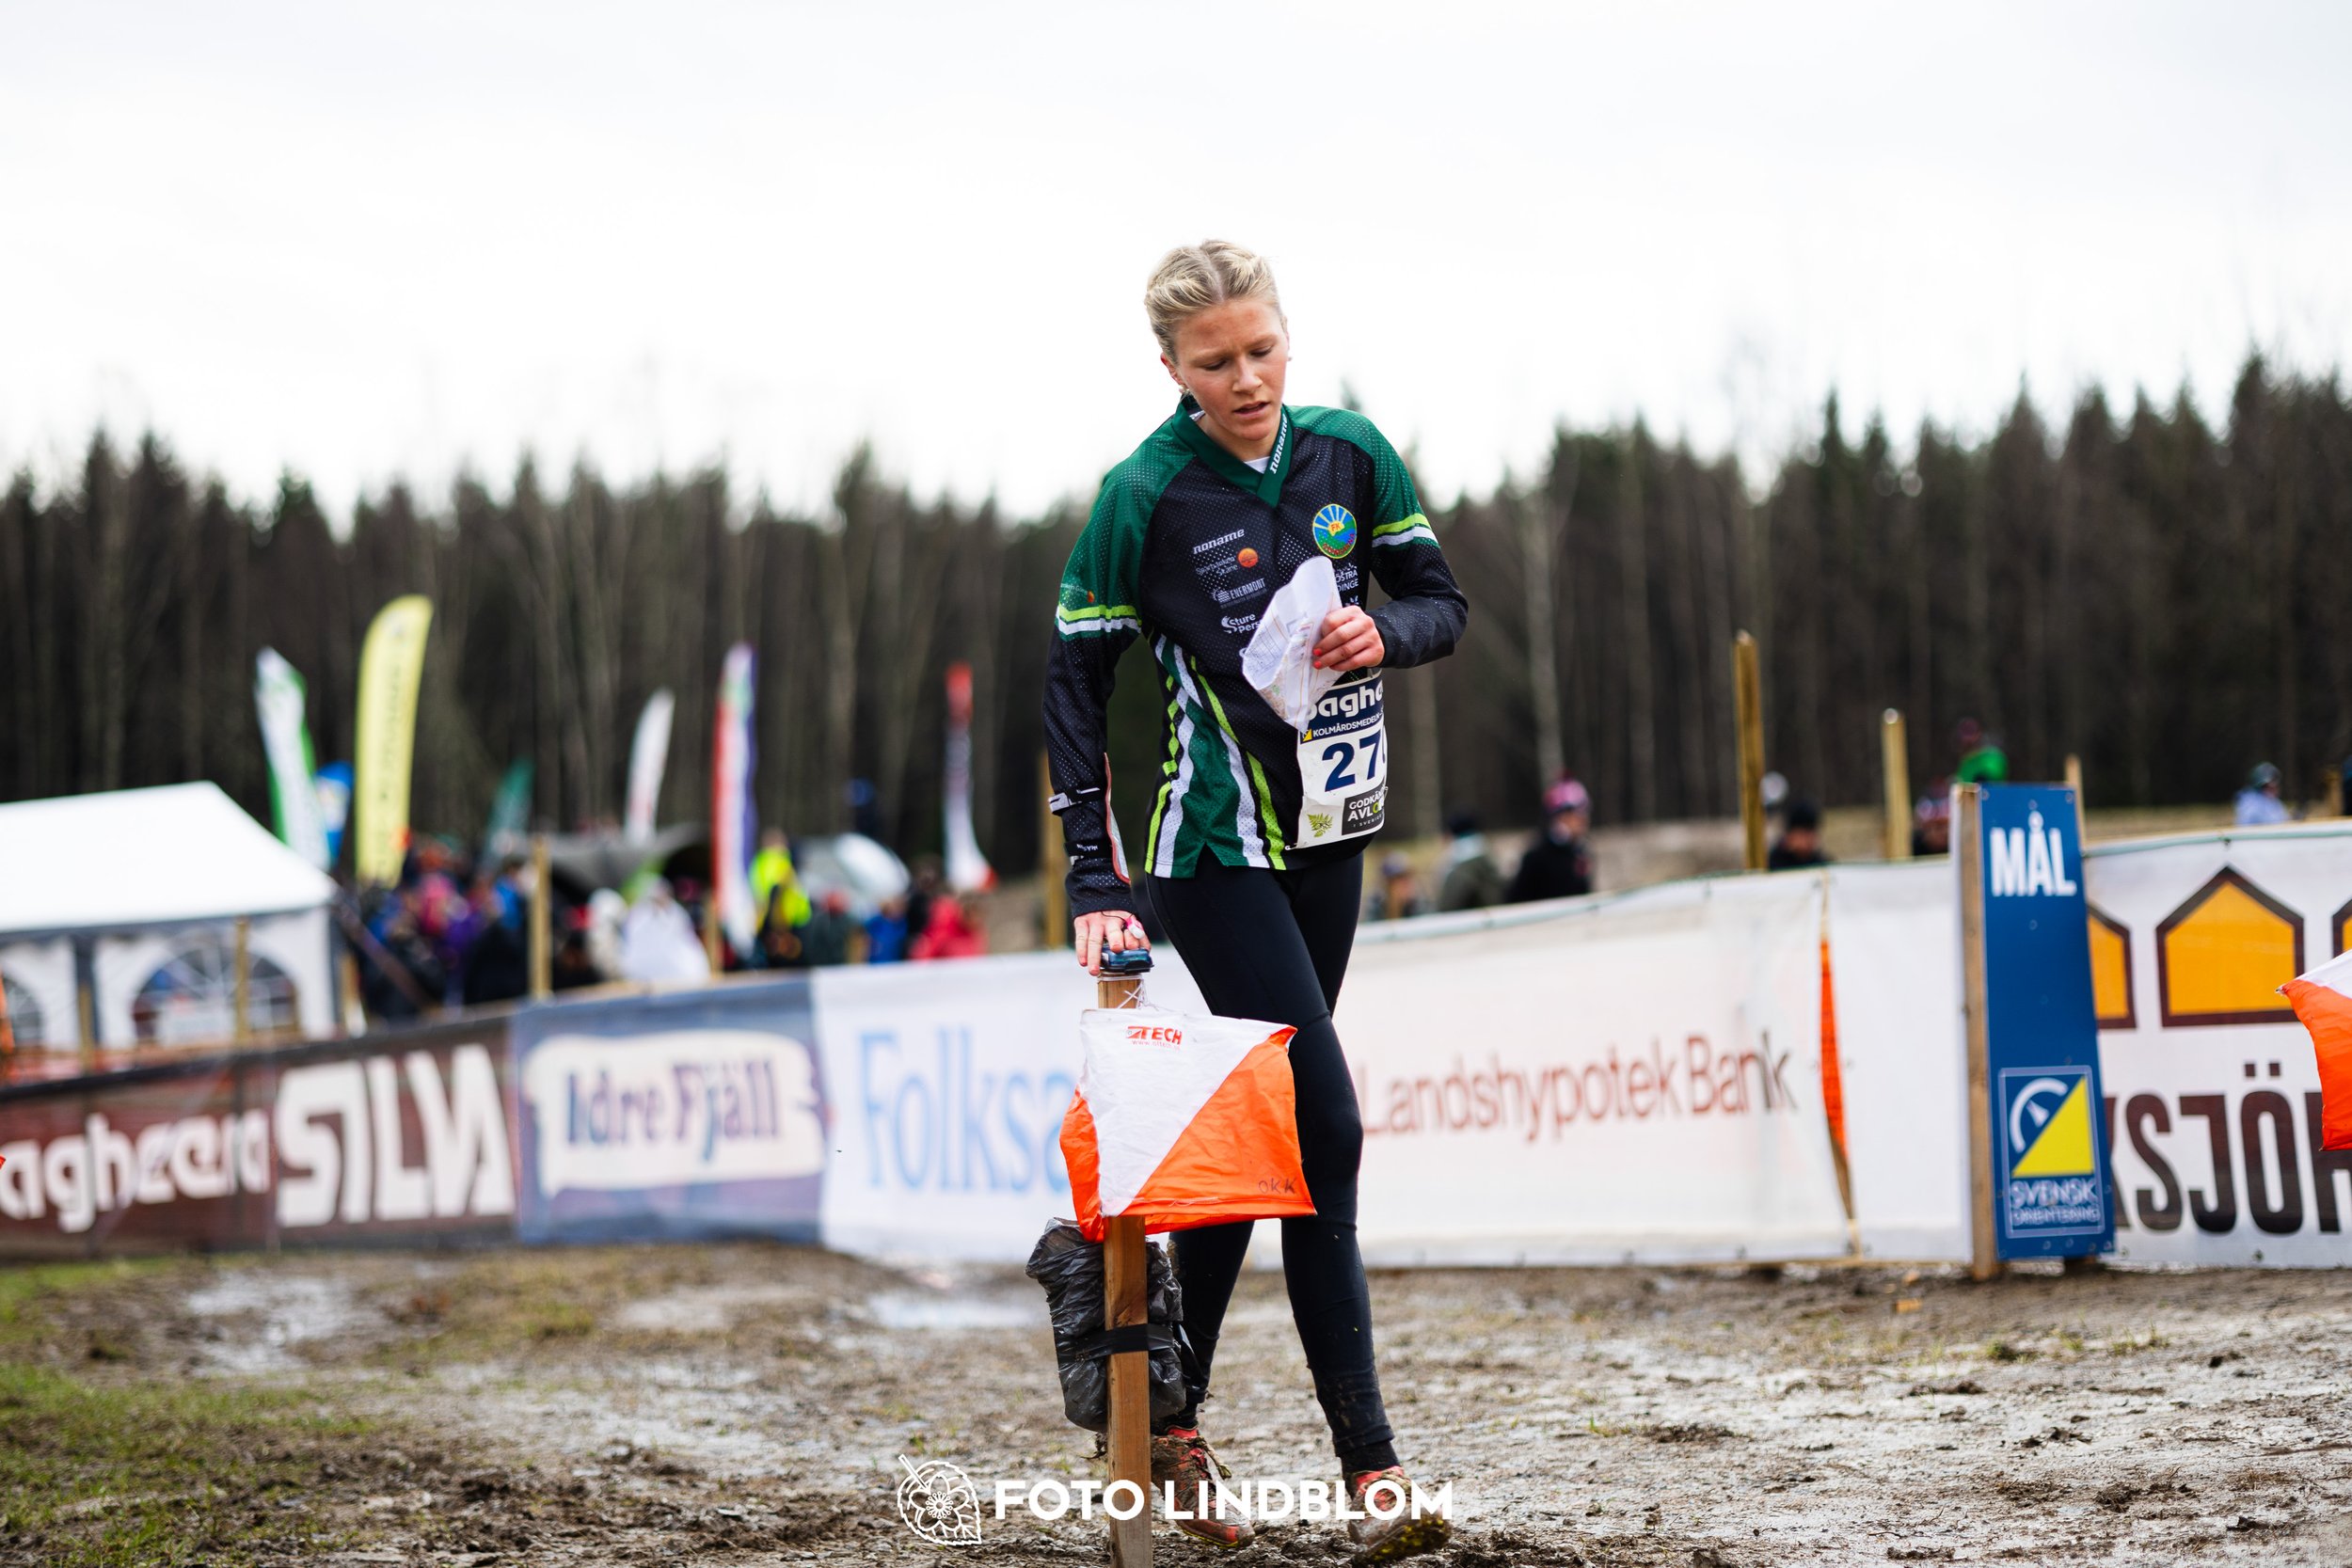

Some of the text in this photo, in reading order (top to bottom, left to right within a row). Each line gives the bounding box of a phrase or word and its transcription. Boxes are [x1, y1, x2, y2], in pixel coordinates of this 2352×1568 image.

[1270, 413, 1288, 475] noname
[1193, 529, 1245, 554] noname
[1230, 578, 1266, 600] ENERMONT
[1322, 728, 1386, 793] 27
[1990, 811, 2077, 897] MÅL
[566, 1053, 783, 1163] Idre Fjäll
[1356, 1031, 1799, 1144] Landshypotek Bank
[277, 1044, 516, 1228] SILVA
[2010, 1177, 2099, 1209] SVENSK
